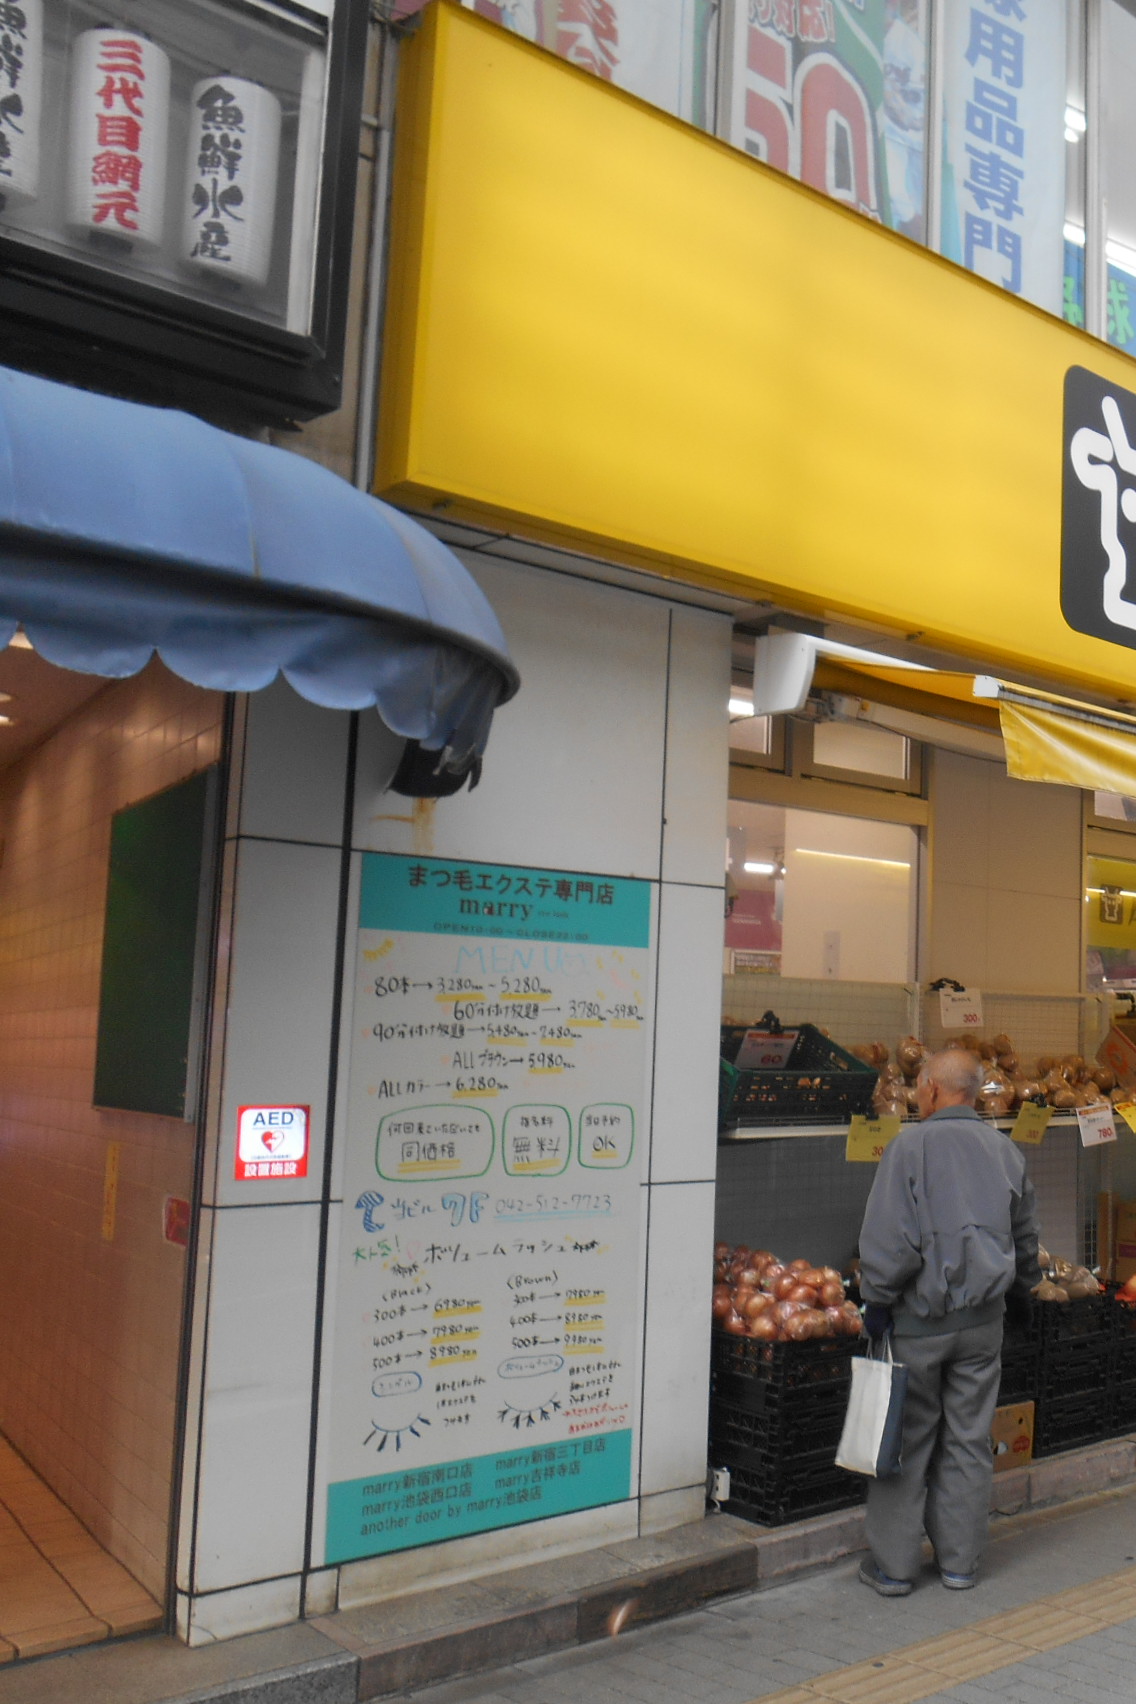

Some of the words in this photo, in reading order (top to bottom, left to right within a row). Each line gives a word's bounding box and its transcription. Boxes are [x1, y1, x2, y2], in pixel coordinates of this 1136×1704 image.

[92, 39, 145, 230] 三代目網元
[190, 84, 246, 263] 魚鮮水産
[408, 864, 615, 906] まつ毛エクステ専門店
[459, 897, 534, 921] marry
[253, 1111, 294, 1126] AED
[401, 1140, 456, 1161] 同価格
[512, 1136, 561, 1164] 無料
[592, 1135, 617, 1152] OK
[244, 1161, 298, 1177] 設置施設
[495, 1438, 607, 1472] marry新宿三丁目店
[361, 1462, 474, 1497] marry新宿南口店
[495, 1459, 582, 1489] marry吉祥寺店
[360, 1515, 410, 1536] another
[414, 1510, 442, 1525] door
[446, 1504, 463, 1519] by
[466, 1485, 544, 1514] marry池袋店
[361, 1482, 473, 1517] marry池袋西口店
